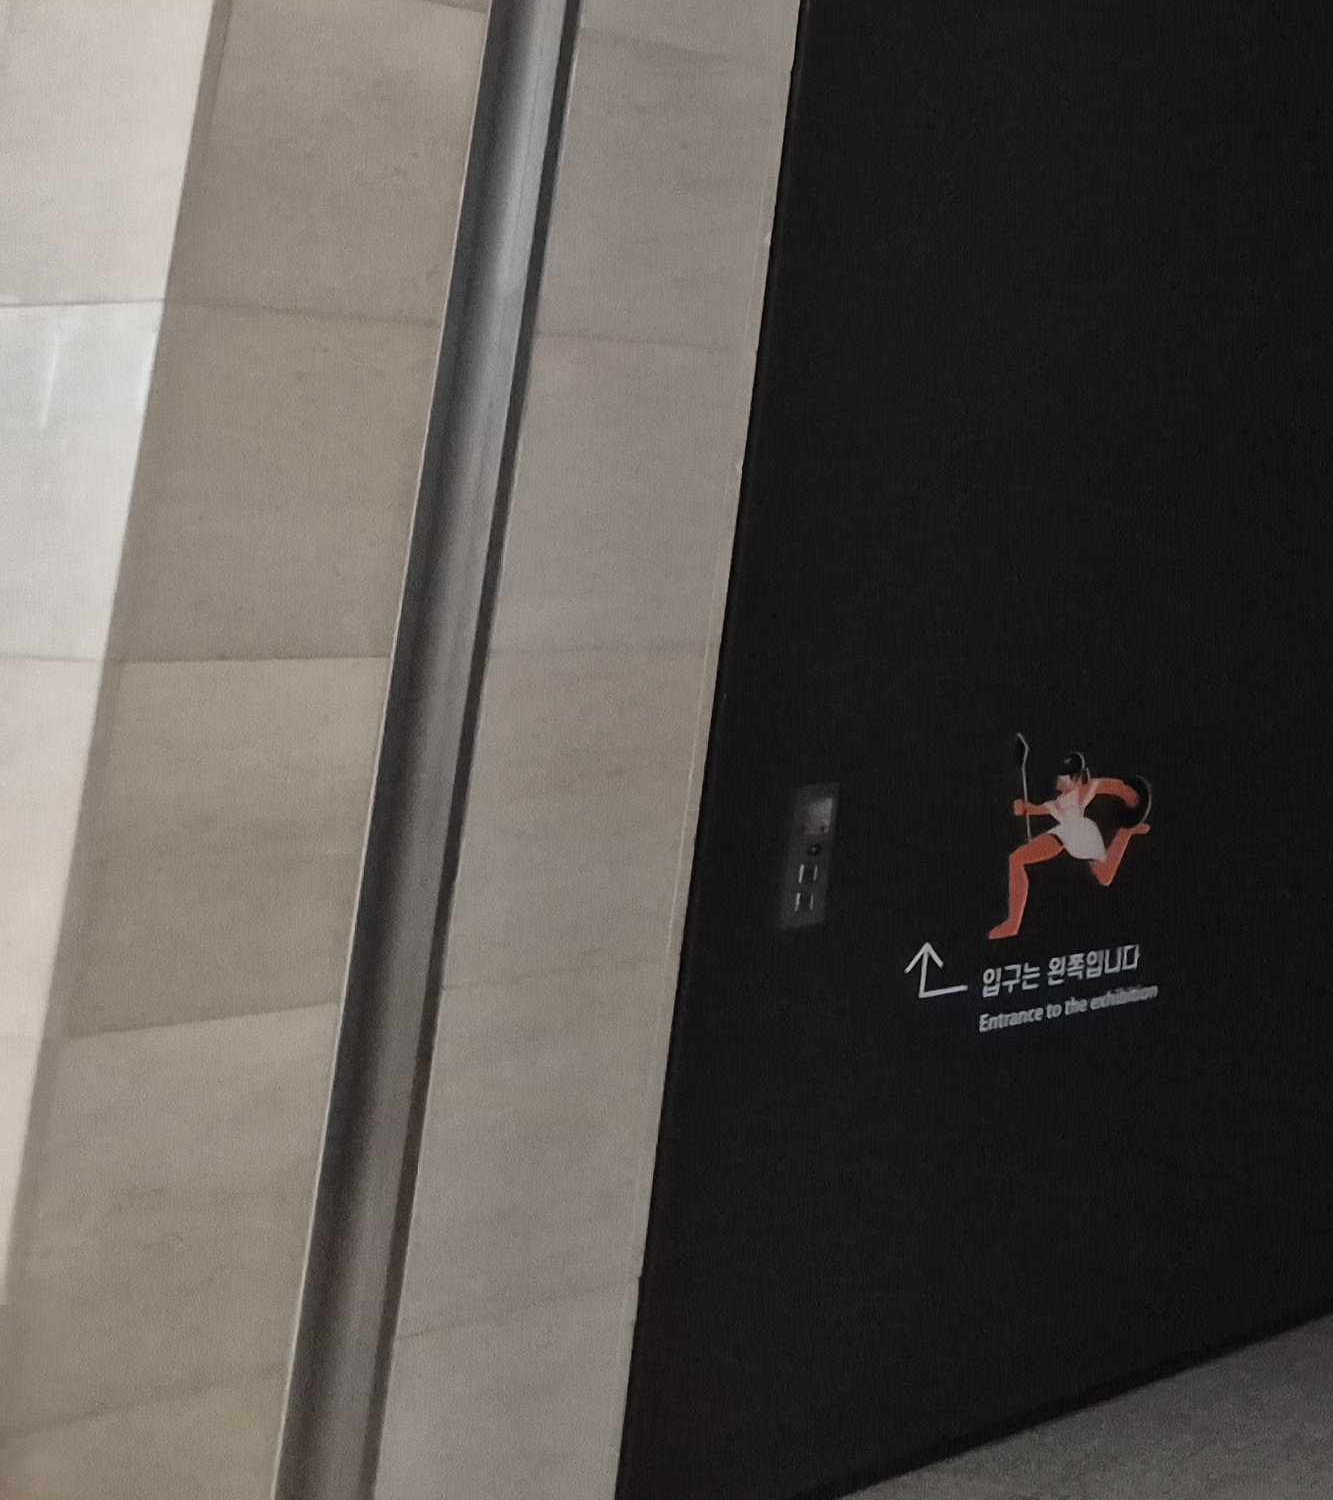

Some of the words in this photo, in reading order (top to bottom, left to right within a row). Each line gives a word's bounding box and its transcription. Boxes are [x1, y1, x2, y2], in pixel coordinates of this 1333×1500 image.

[982, 962, 1041, 998] 입구는
[1046, 943, 1141, 986] 왼쪽입니다
[979, 1006, 1044, 1033] Entrance
[1045, 1003, 1063, 1019] to
[1064, 996, 1088, 1016] the
[1089, 984, 1159, 1011] exhibition
